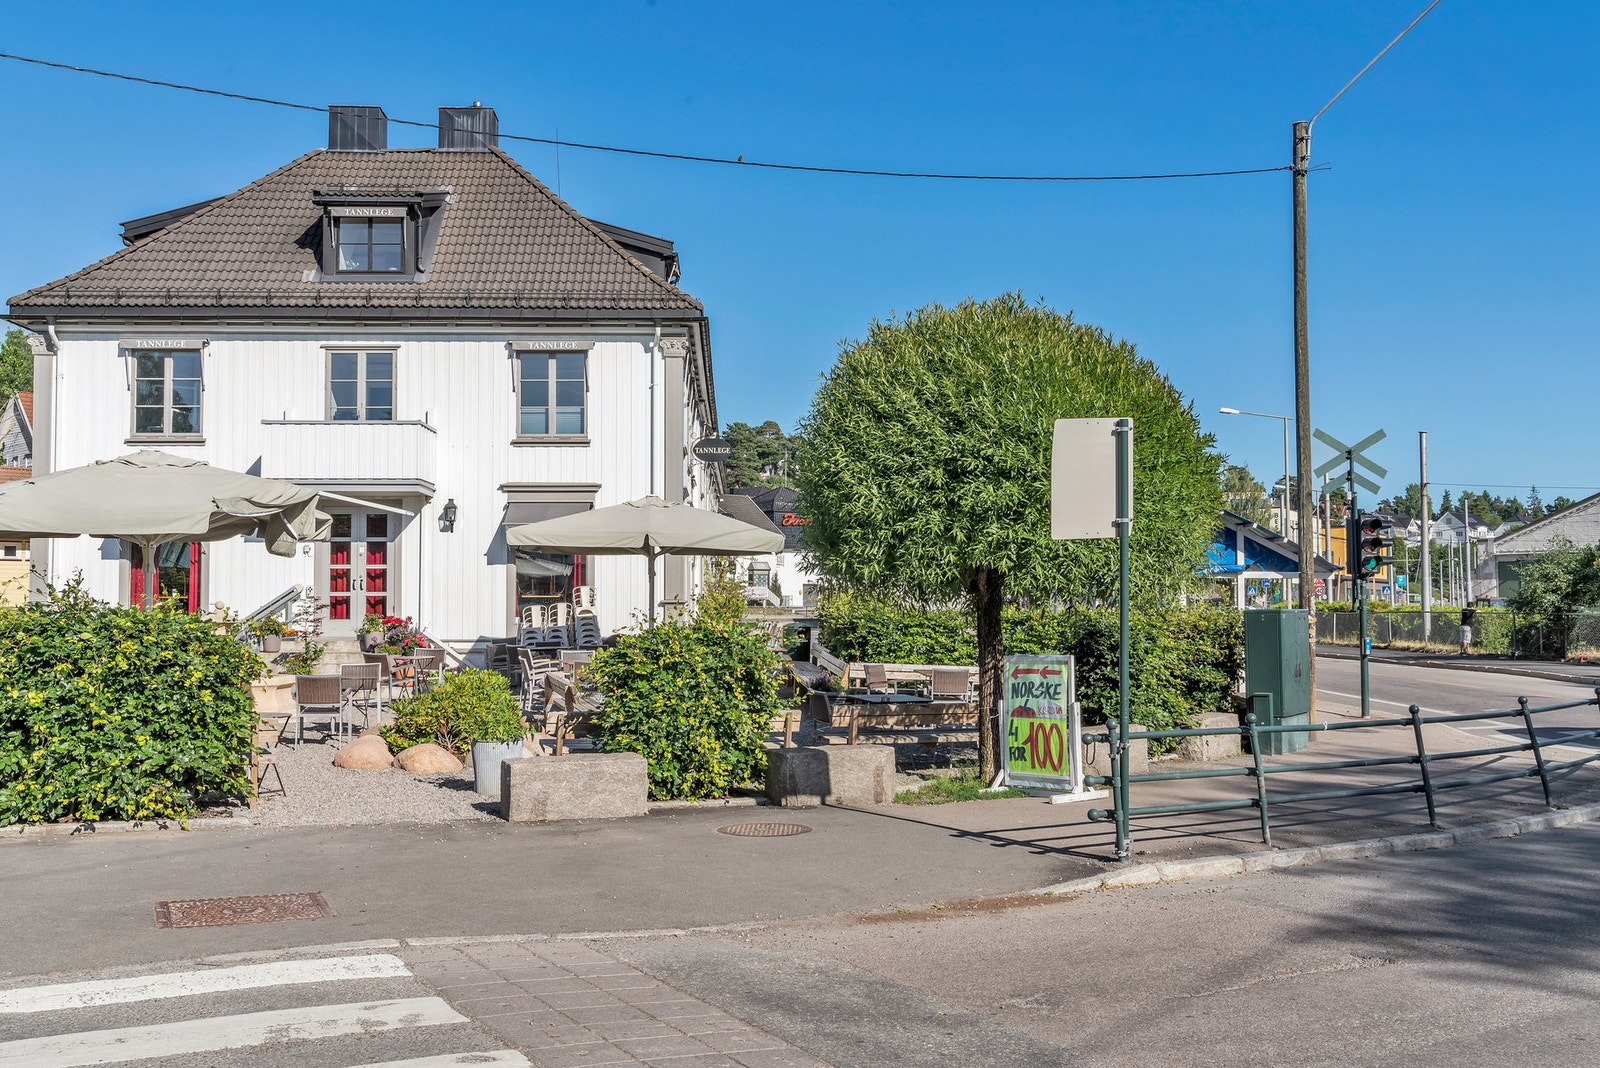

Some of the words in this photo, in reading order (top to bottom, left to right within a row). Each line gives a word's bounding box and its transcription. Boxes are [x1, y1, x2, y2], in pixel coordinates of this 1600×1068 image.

[344, 208, 394, 216] TANNLEGE
[135, 340, 187, 348] TANNLEGE
[527, 341, 578, 350] TANNLEGE
[1011, 681, 1062, 700] NORSKE
[1008, 719, 1018, 742] 4
[1009, 746, 1027, 762] FOR
[1021, 722, 1064, 773] 100
